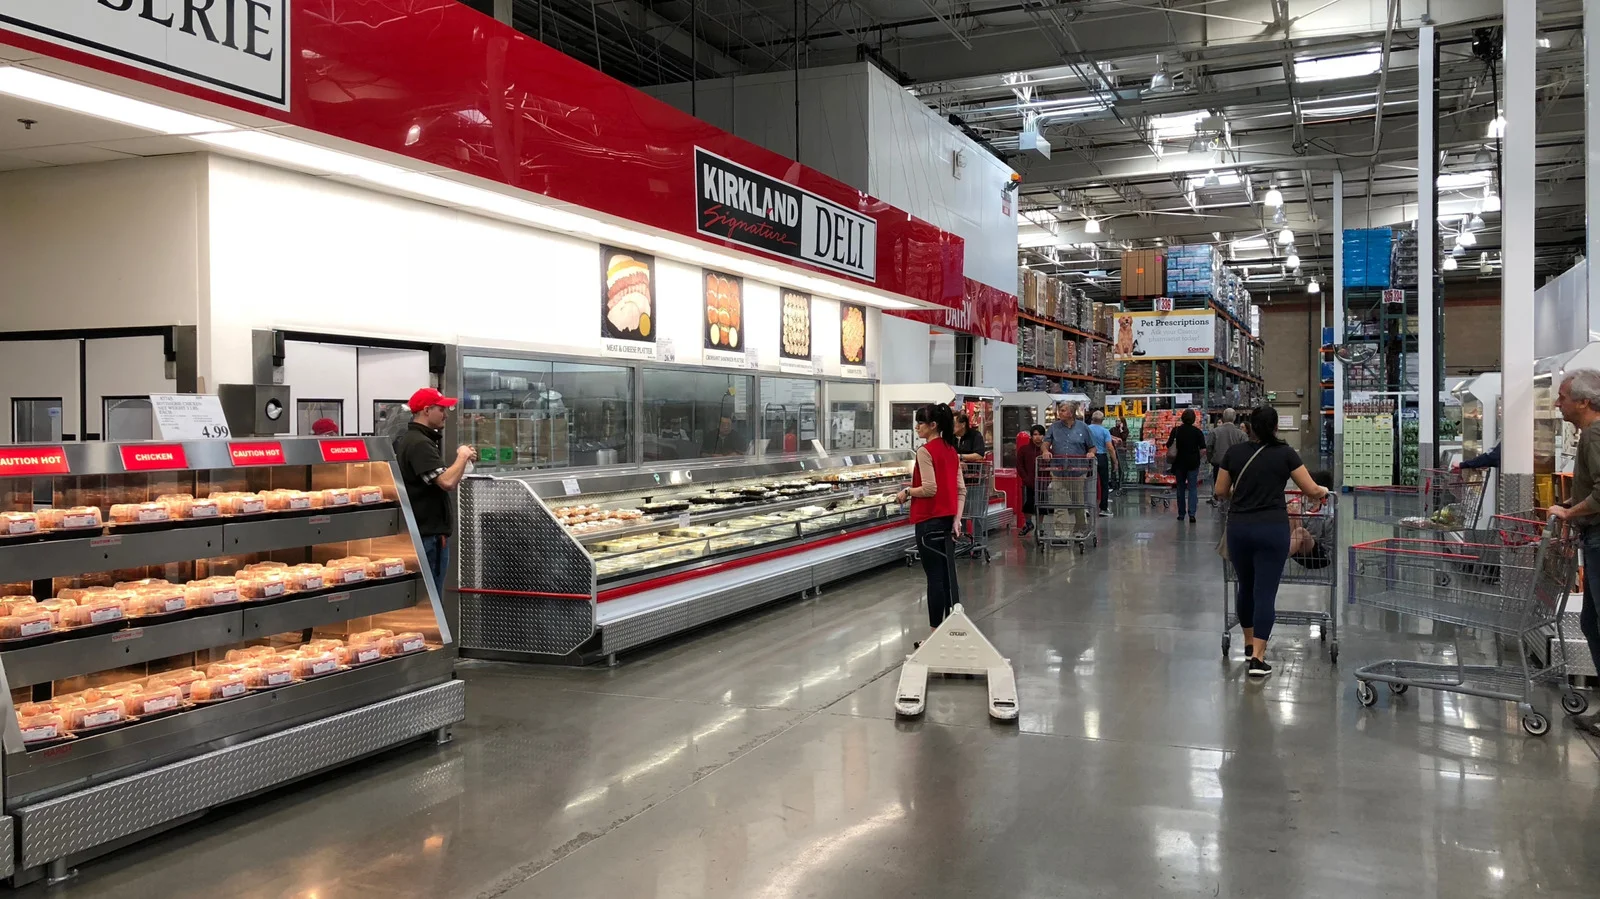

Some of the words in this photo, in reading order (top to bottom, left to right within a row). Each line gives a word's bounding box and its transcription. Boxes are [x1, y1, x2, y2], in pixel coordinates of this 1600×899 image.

[97, 0, 273, 61] RIE
[703, 163, 799, 228] KIRKLAND
[703, 204, 798, 246] Signature
[814, 205, 865, 270] DELI
[945, 299, 972, 330] DAIRY
[1141, 319, 1154, 327] Pet
[1155, 318, 1210, 327] Prescriptions
[606, 344, 619, 352] MEAT
[637, 347, 653, 355] PLATTER
[202, 425, 229, 438] 4.99
[233, 449, 265, 458] CAUTION
[330, 446, 358, 454] CHICKEN
[40, 456, 61, 464] HOT
[135, 453, 173, 461] CHICKEN
